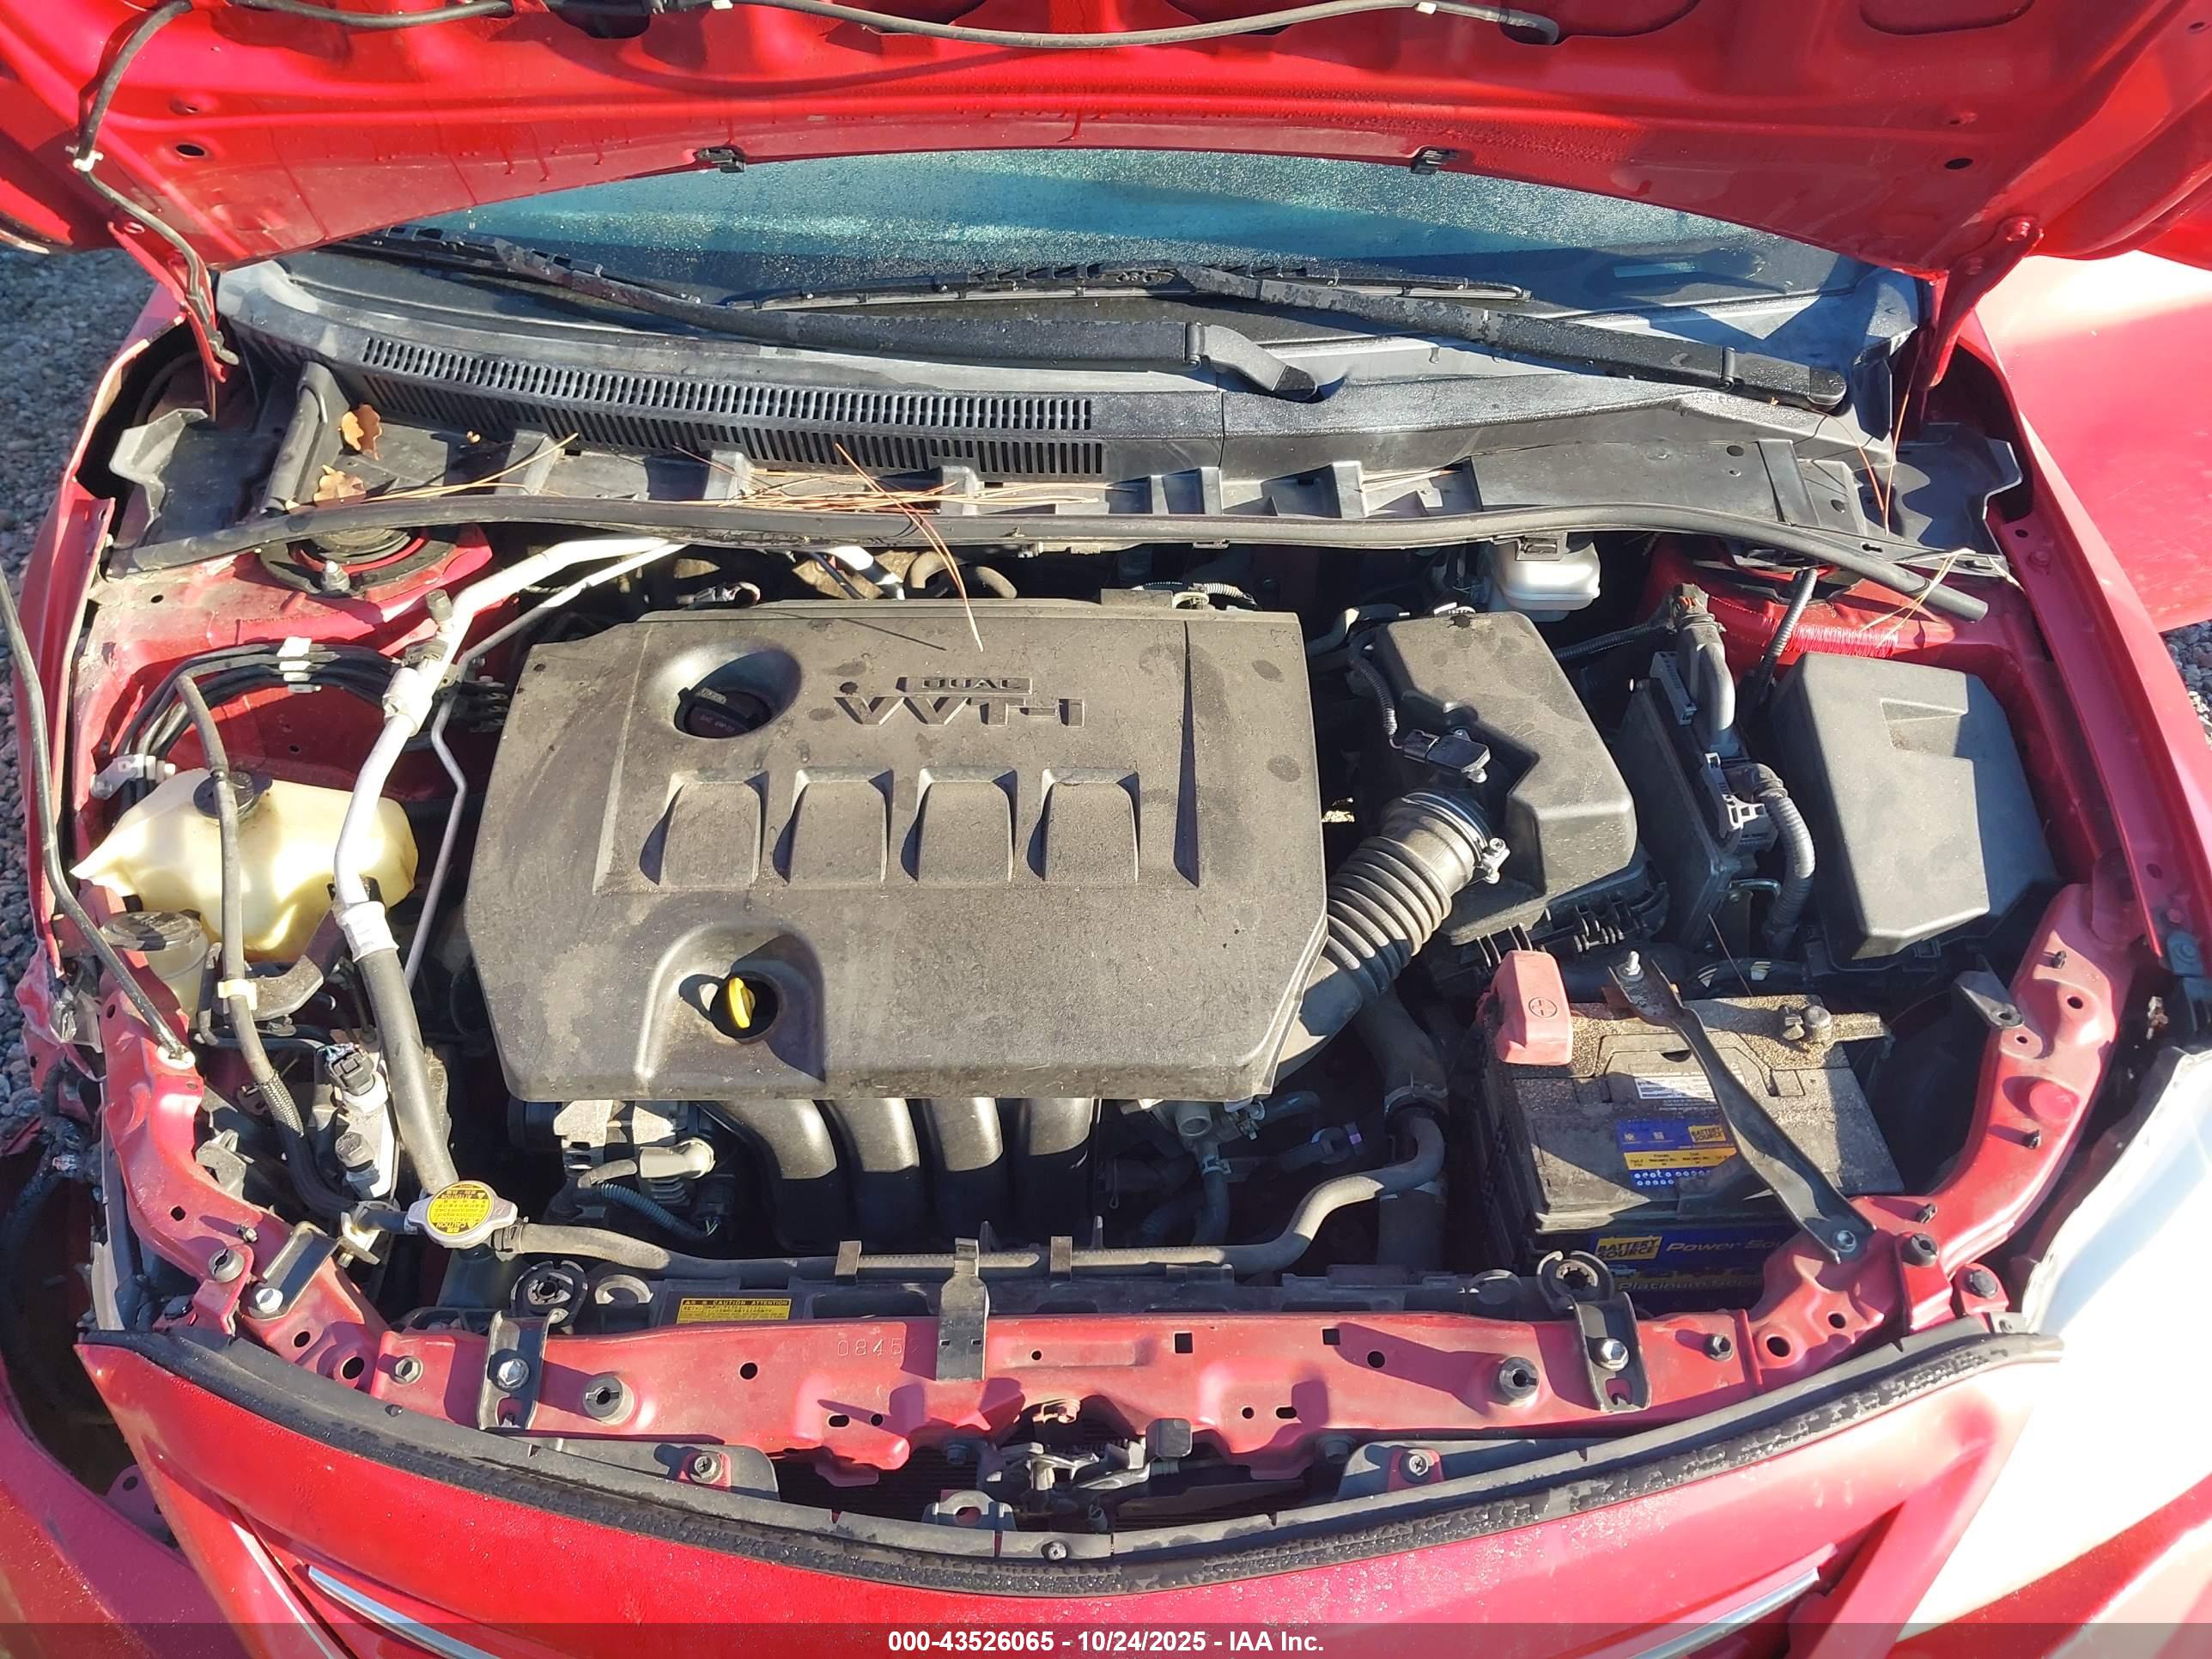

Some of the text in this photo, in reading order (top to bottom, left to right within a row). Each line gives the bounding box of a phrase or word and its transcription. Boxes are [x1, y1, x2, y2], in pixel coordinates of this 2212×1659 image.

[921, 678, 1022, 690] DUAL
[1598, 1237, 1659, 1252] BATTERY
[1666, 1242, 1741, 1252] Power
[1597, 1247, 1655, 1260] SOURCE
